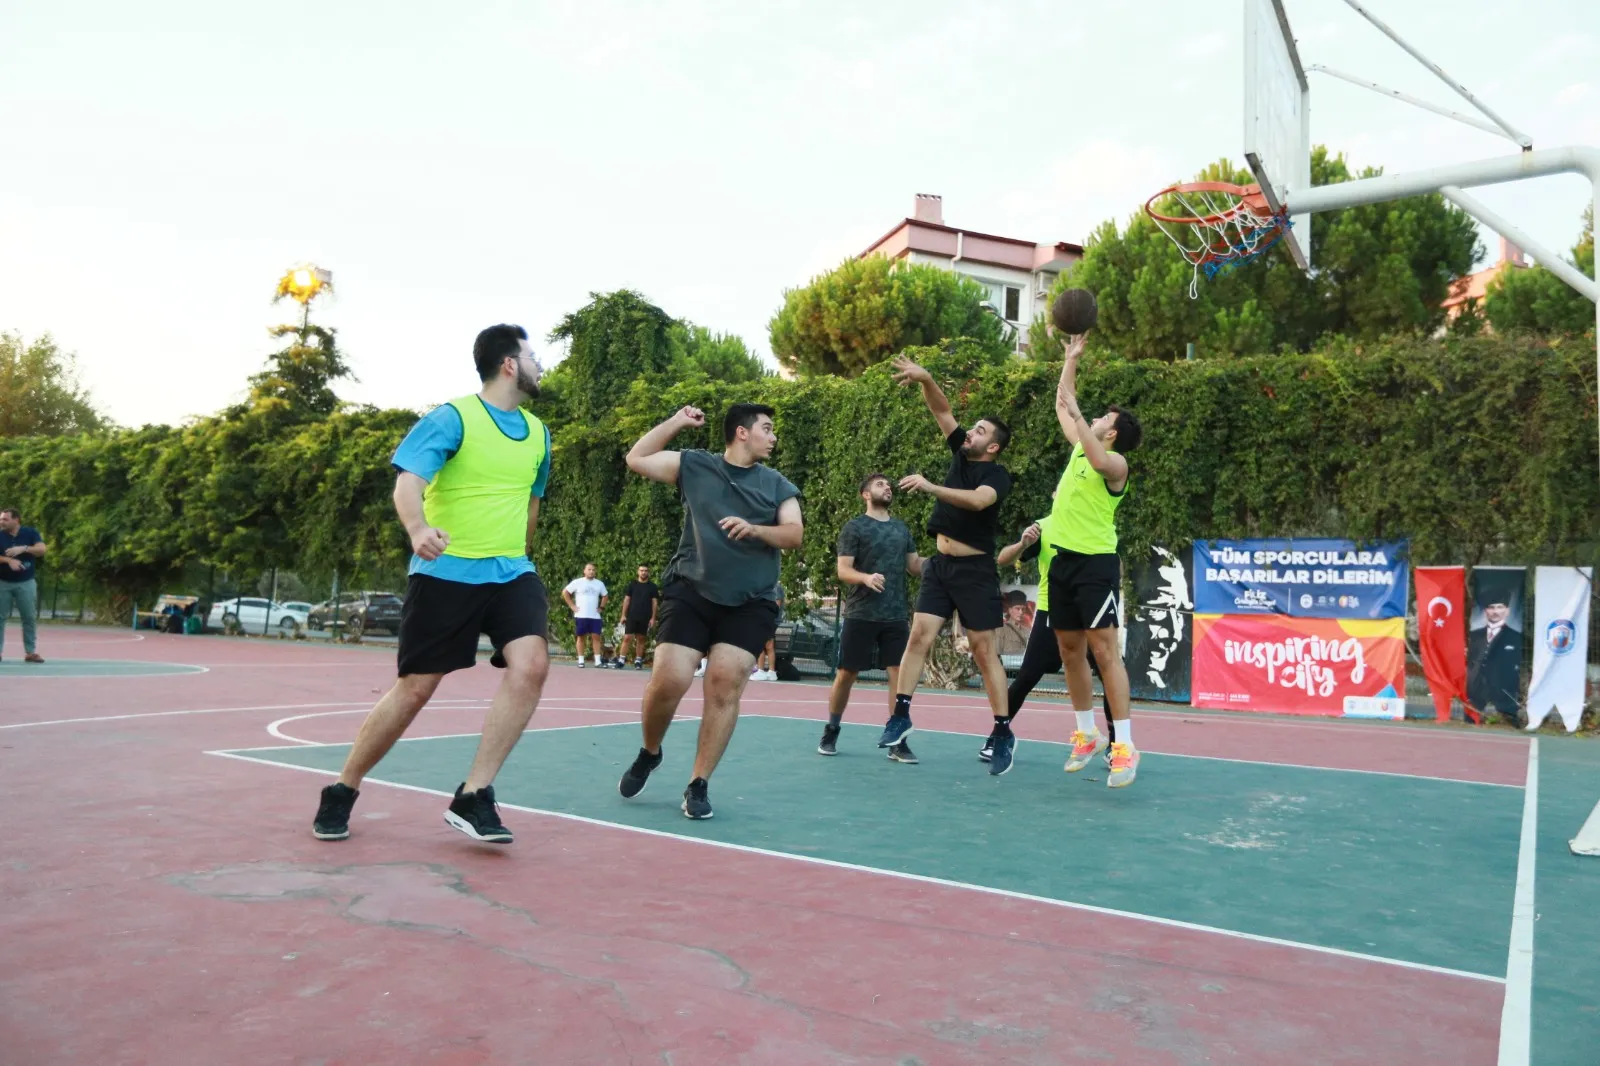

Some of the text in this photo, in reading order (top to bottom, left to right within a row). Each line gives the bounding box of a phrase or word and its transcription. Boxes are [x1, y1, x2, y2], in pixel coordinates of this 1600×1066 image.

[1210, 547, 1387, 566] TÜM SPORCULARA
[1206, 568, 1393, 585] BAŞARILAR DİLERİM
[1224, 635, 1368, 684] inspiring
[1280, 654, 1338, 697] city
